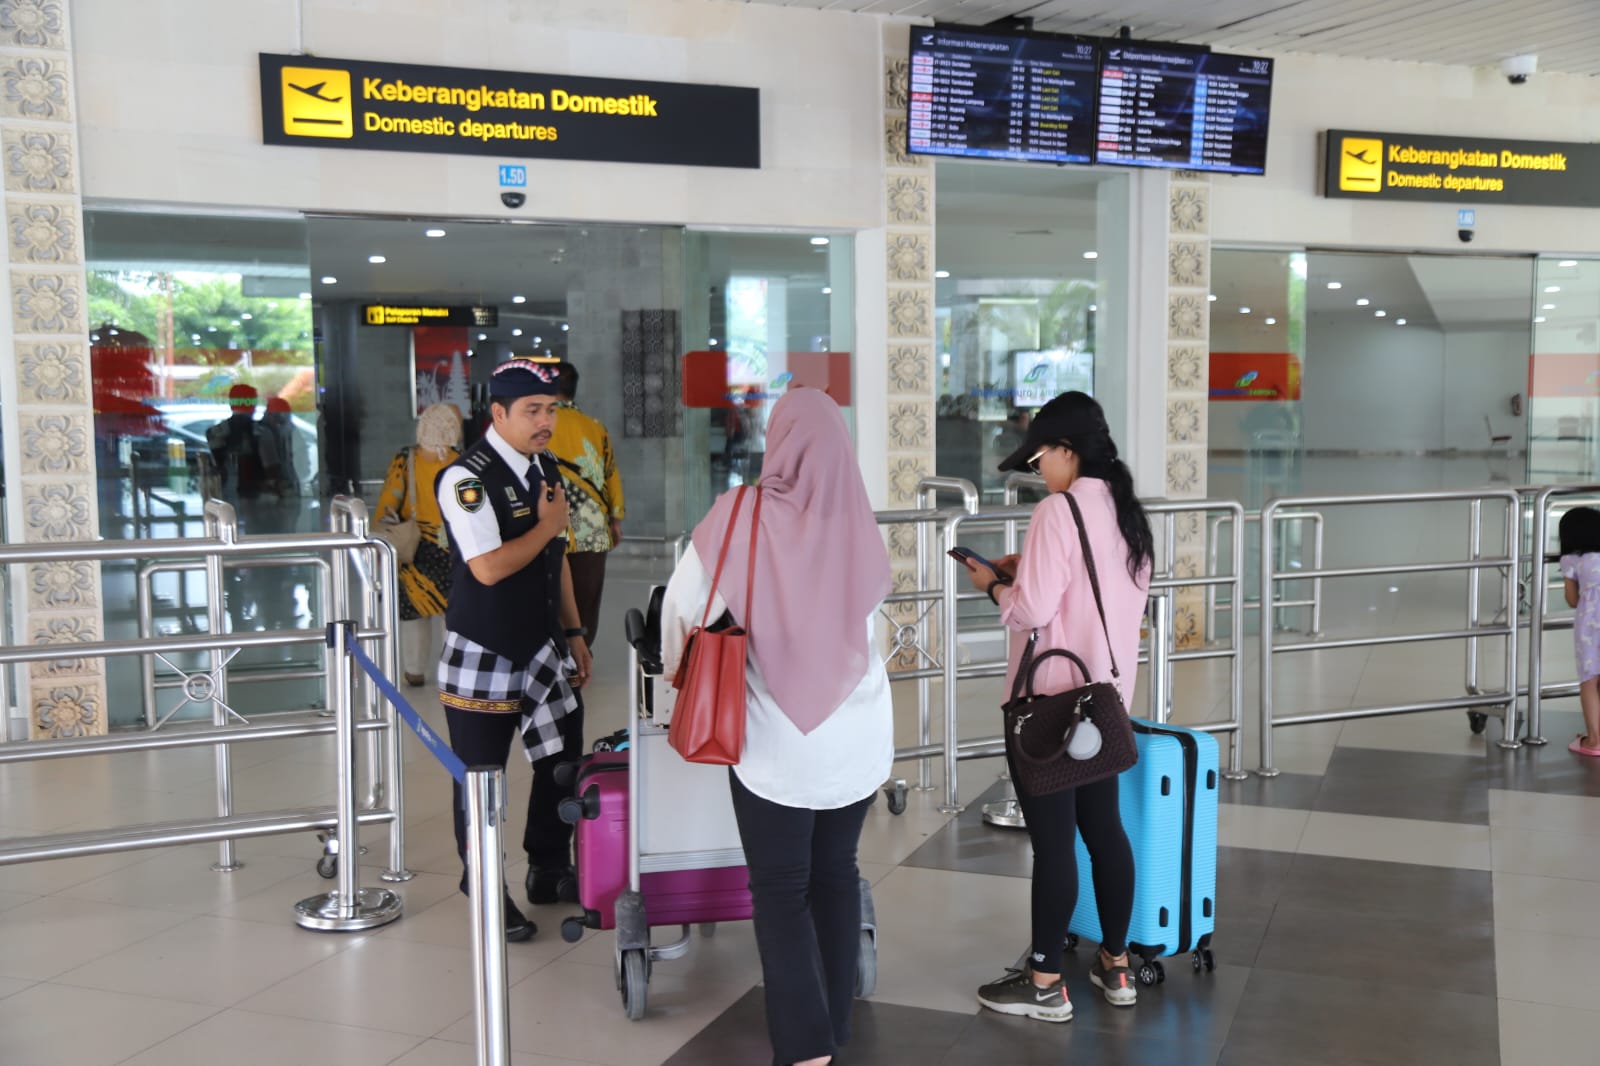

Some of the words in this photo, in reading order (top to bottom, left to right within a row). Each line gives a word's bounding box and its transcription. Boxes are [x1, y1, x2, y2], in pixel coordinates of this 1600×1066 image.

[937, 37, 966, 48] Informasi
[966, 40, 1010, 51] Keberangkatan
[1076, 45, 1092, 54] 10:27
[363, 78, 545, 111] Keberangkatan
[551, 90, 657, 117] Domestik
[364, 112, 455, 135] Domestic
[458, 118, 557, 141] departures
[1389, 145, 1498, 169] Keberangkatan
[1500, 150, 1567, 171] Domestik
[500, 166, 526, 185] 1.5D
[1387, 171, 1442, 189] Domestic
[1443, 174, 1504, 193] departures
